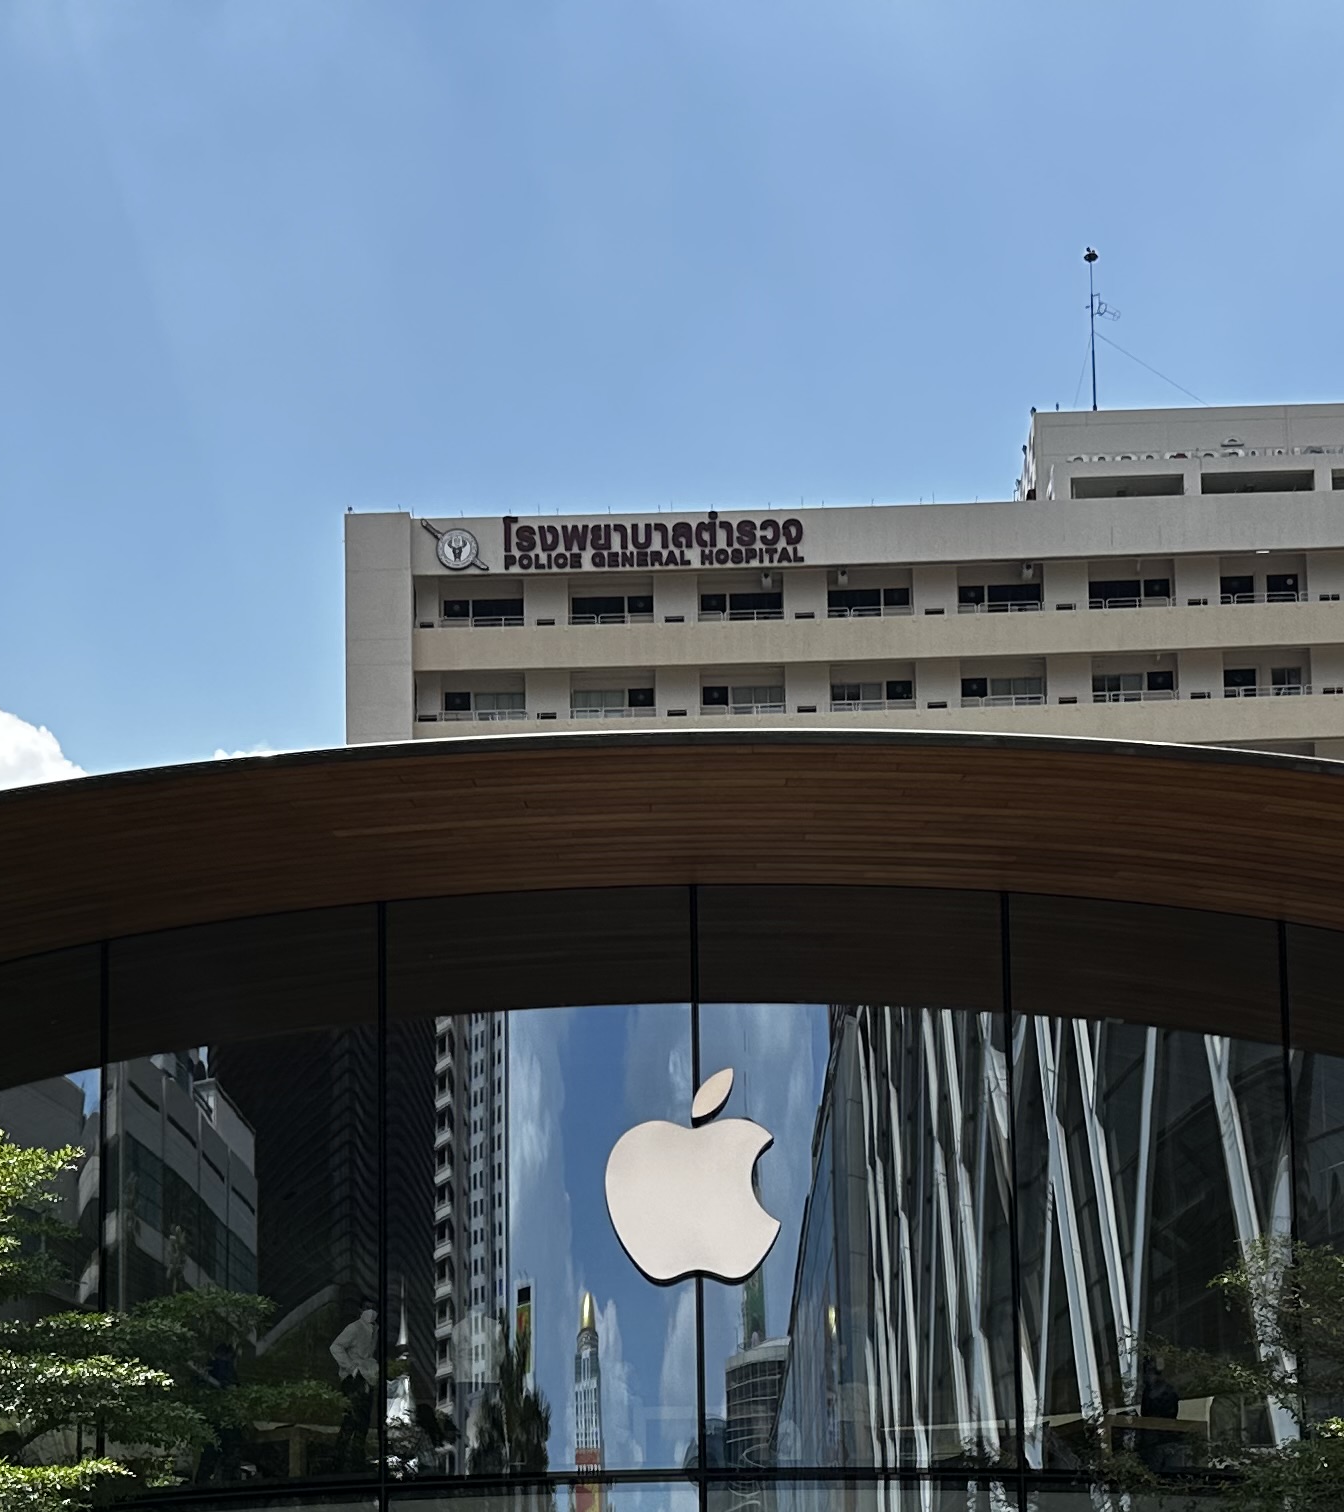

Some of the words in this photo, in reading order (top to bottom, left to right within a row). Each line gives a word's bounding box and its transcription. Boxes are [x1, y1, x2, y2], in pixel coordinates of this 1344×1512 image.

[503, 511, 804, 553] โรงพยาบาลตำรวจ
[504, 553, 582, 570] POLICE
[591, 549, 691, 568] GENERAL
[700, 546, 805, 565] HOSPITAL
